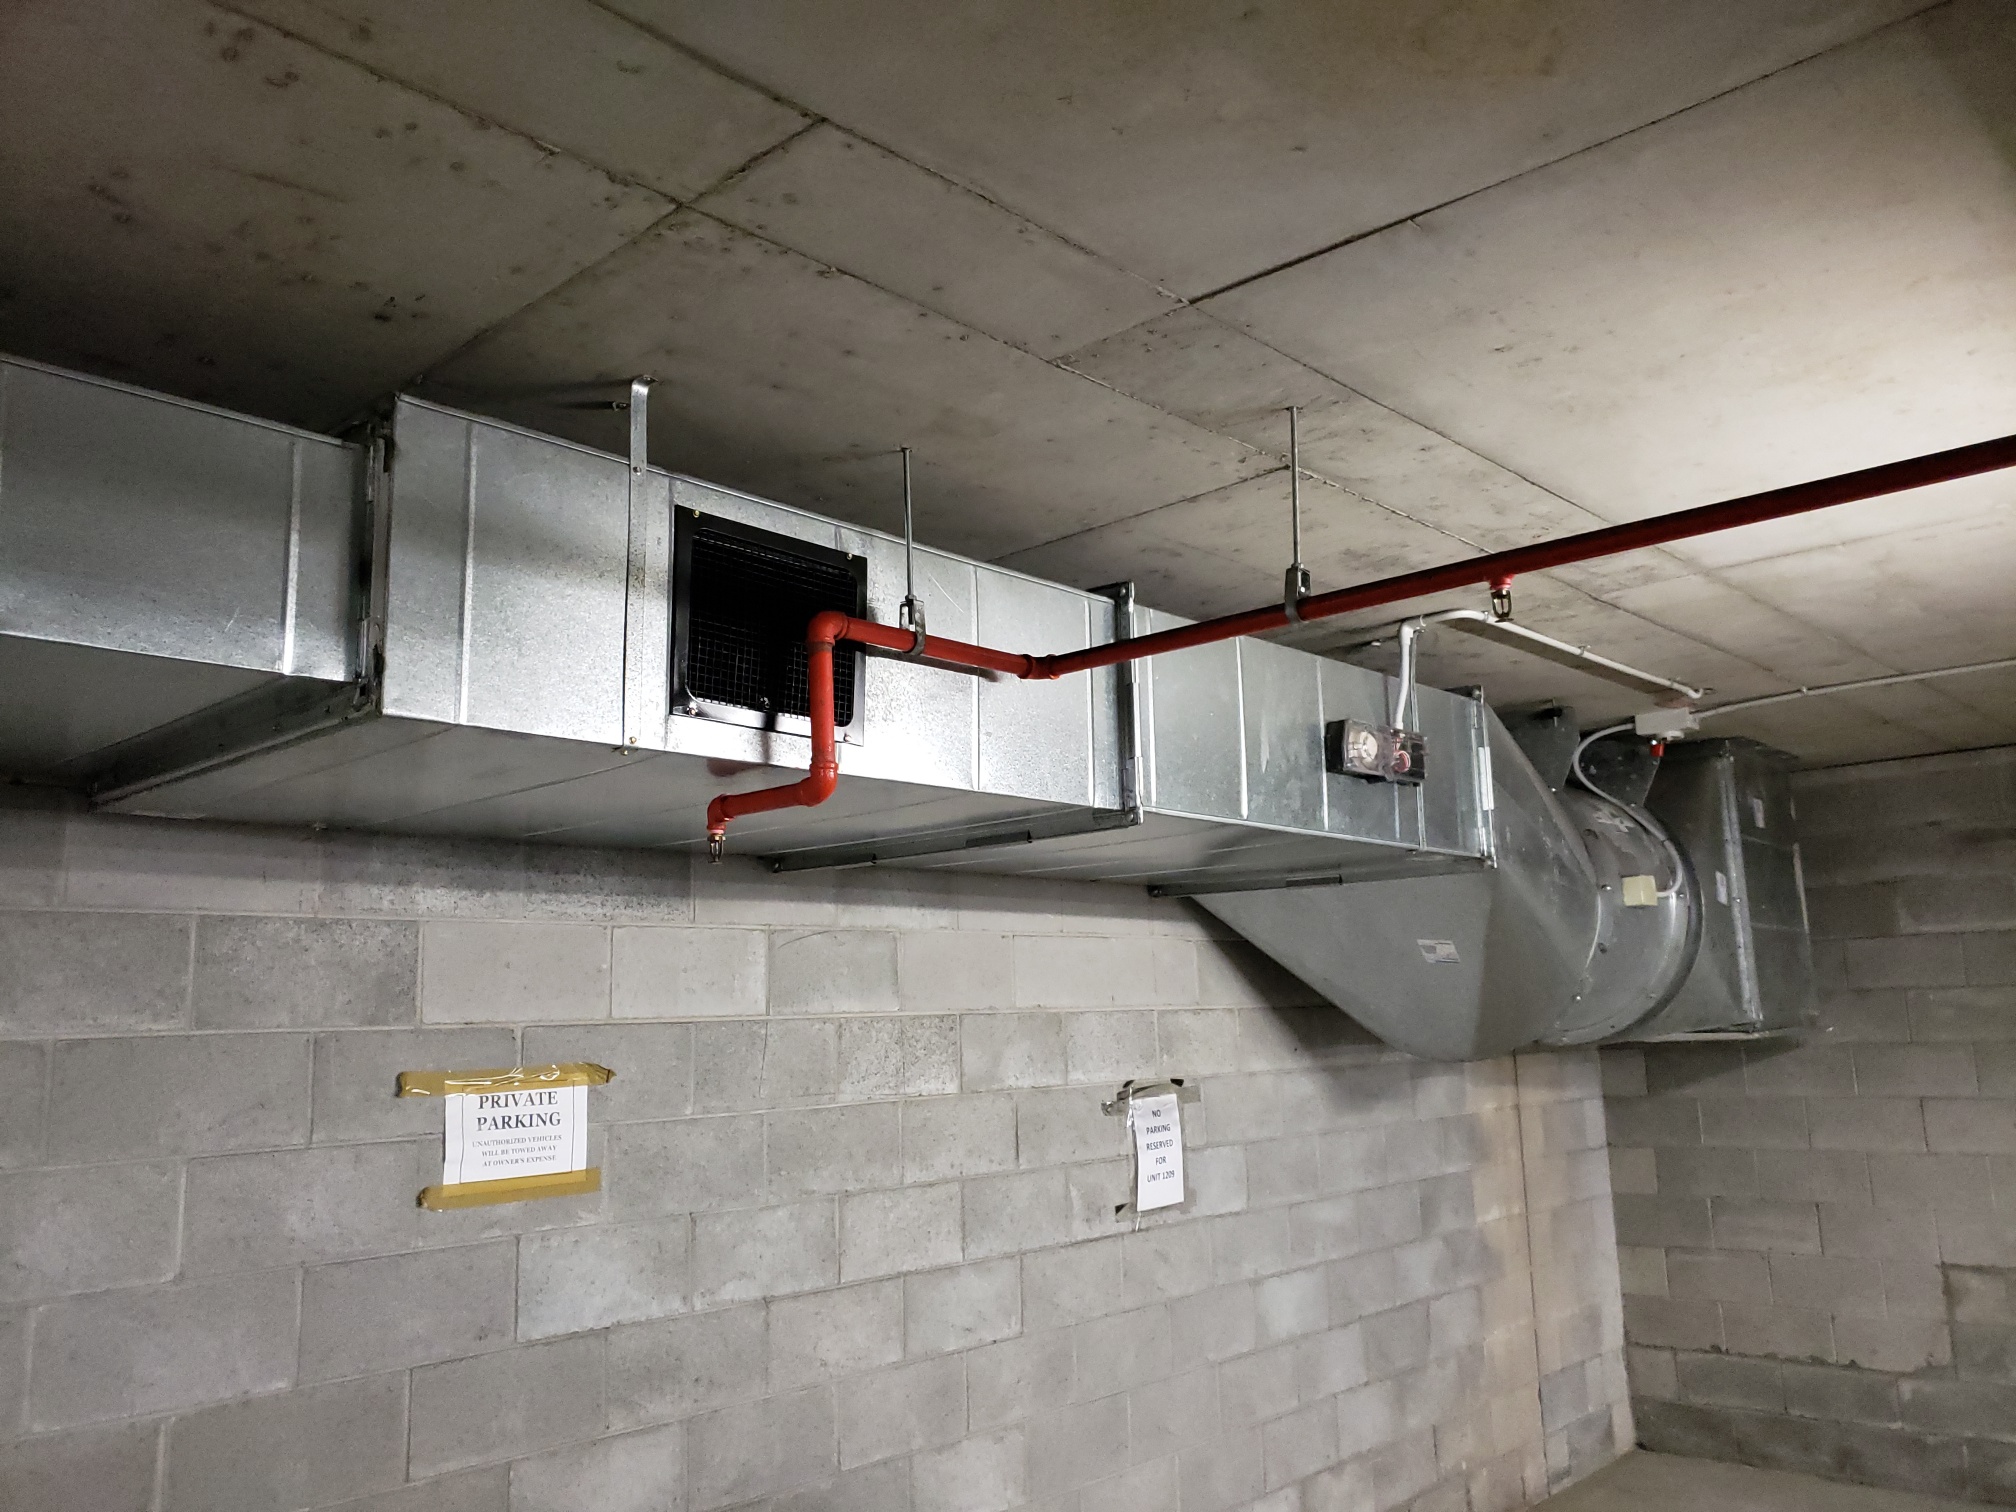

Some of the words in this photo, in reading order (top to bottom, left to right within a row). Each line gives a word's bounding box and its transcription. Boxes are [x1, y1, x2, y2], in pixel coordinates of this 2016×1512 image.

[478, 1091, 558, 1109] PRIVATE
[1152, 1109, 1161, 1118] NO
[476, 1111, 561, 1131] PARKING
[1146, 1123, 1171, 1135] PARKING
[472, 1137, 527, 1148] UNAUTHORIZED
[527, 1134, 562, 1143] VEHICLES
[1146, 1139, 1174, 1151] RESERVED
[481, 1149, 501, 1157] WILL
[511, 1146, 536, 1155] TOWED
[537, 1144, 557, 1152] AWAY
[493, 1157, 525, 1166] OWNER'S
[526, 1155, 557, 1163] EXPENSE
[1155, 1156, 1167, 1166] FOR
[1147, 1172, 1161, 1183] UNIT
[1162, 1170, 1175, 1180] 1209
